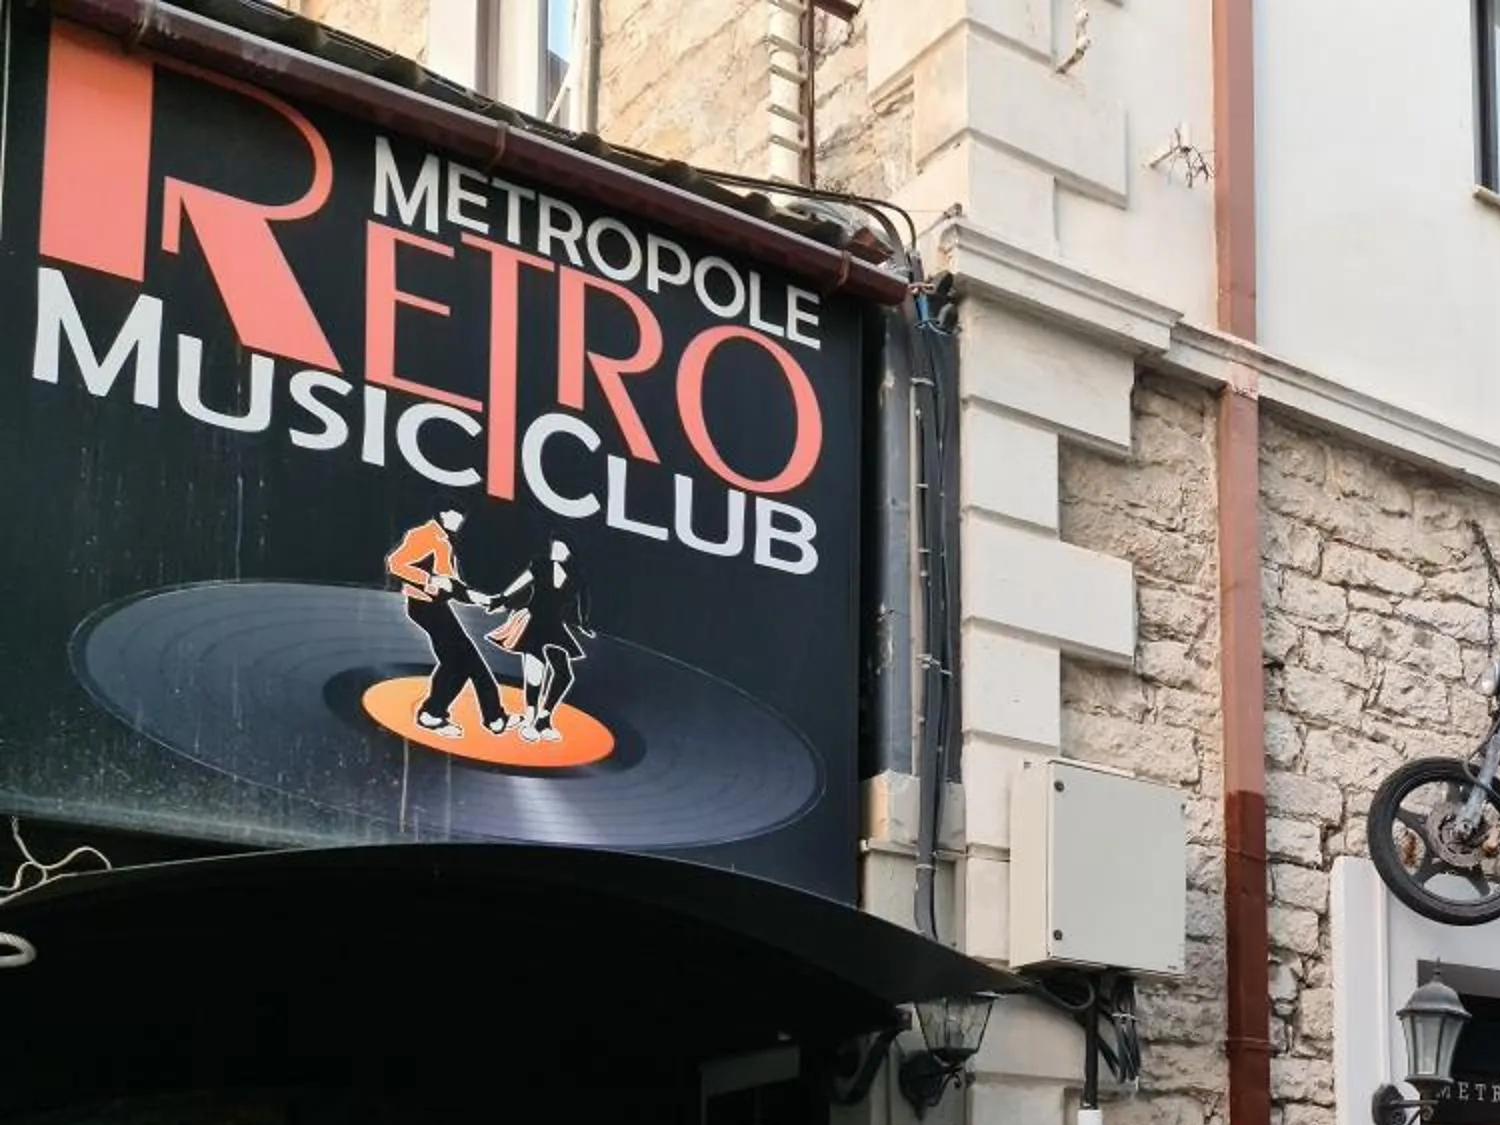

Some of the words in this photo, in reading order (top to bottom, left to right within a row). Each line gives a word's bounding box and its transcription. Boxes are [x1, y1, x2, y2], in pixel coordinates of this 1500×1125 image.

[38, 18, 823, 501] RETRO
[372, 136, 822, 350] METROPOLE
[33, 267, 483, 487] MUSIC
[522, 413, 819, 575] CLUB
